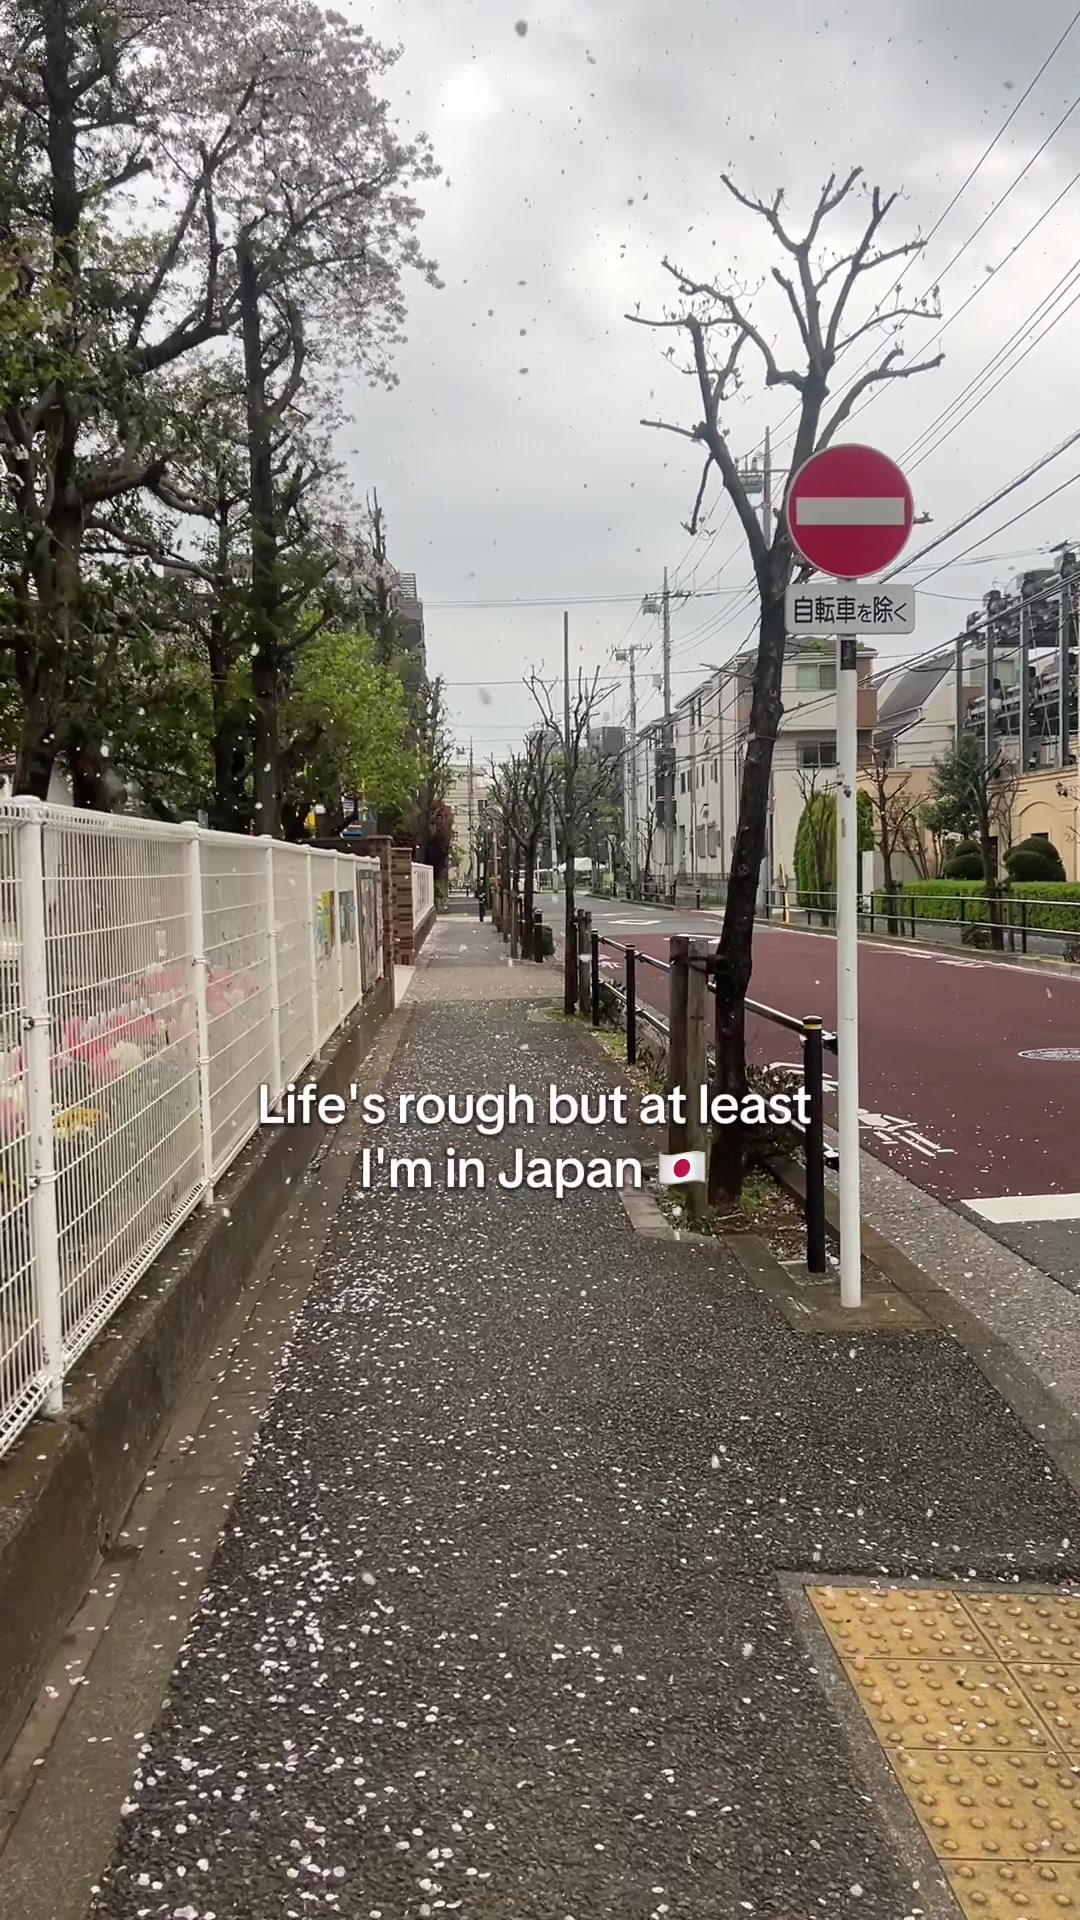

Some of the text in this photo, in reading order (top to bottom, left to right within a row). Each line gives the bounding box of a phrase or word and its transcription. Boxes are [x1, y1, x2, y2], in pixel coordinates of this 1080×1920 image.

[794, 595, 907, 624] 自転車を除く
